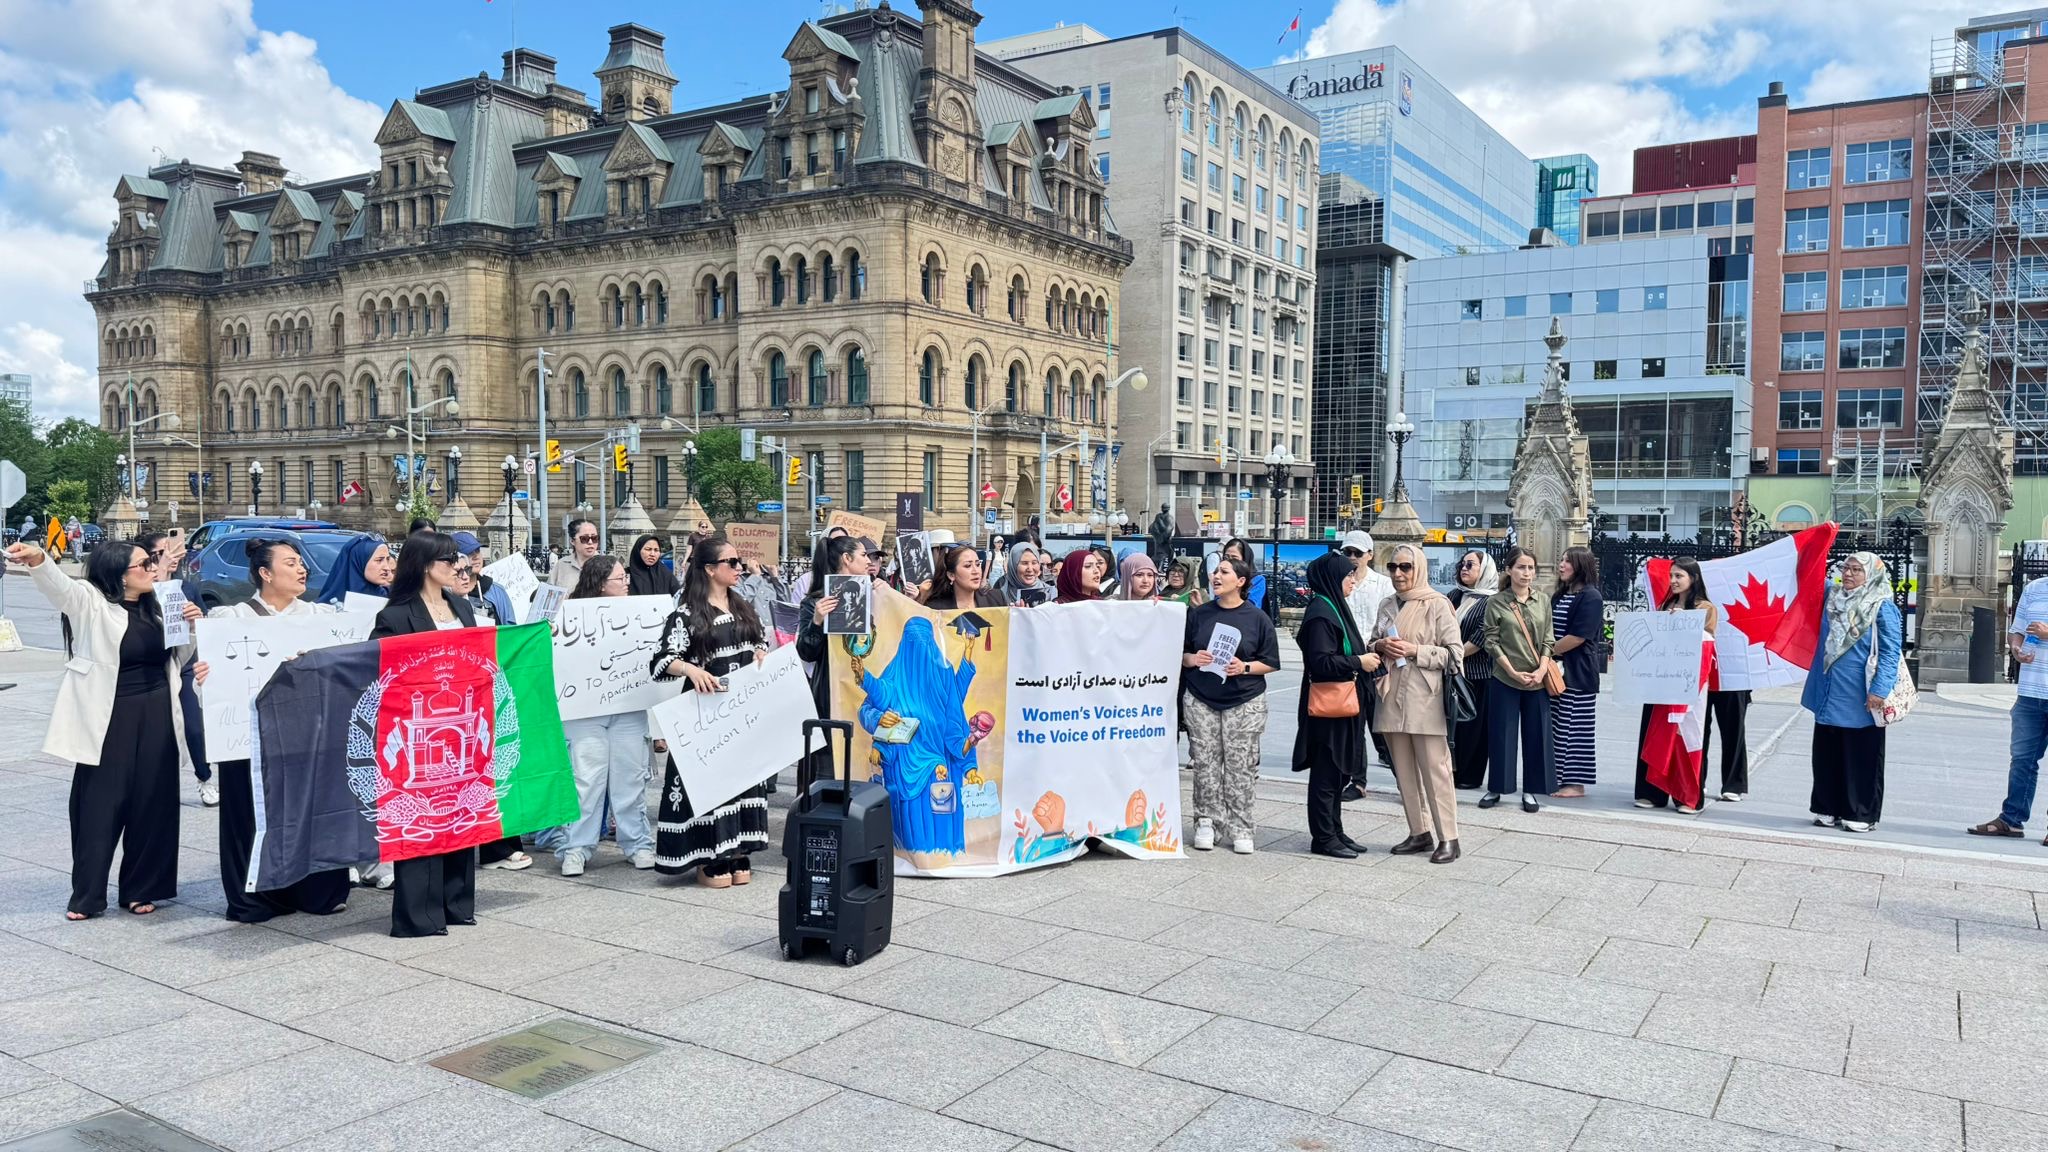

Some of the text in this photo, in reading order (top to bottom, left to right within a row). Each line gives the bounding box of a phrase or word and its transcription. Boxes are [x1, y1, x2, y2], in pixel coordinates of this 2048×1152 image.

[1289, 65, 1384, 101] Canada
[1454, 515, 1477, 527] 90
[735, 541, 760, 550] WORK
[736, 550, 765, 558] REEDOM
[1015, 675, 1049, 687] است
[1052, 672, 1082, 691] آزادی
[1083, 675, 1116, 689] صدای
[1138, 673, 1168, 688] صدای
[1022, 704, 1163, 722] Women's Voices Are
[1017, 724, 1165, 744] the Voice of Freedom
